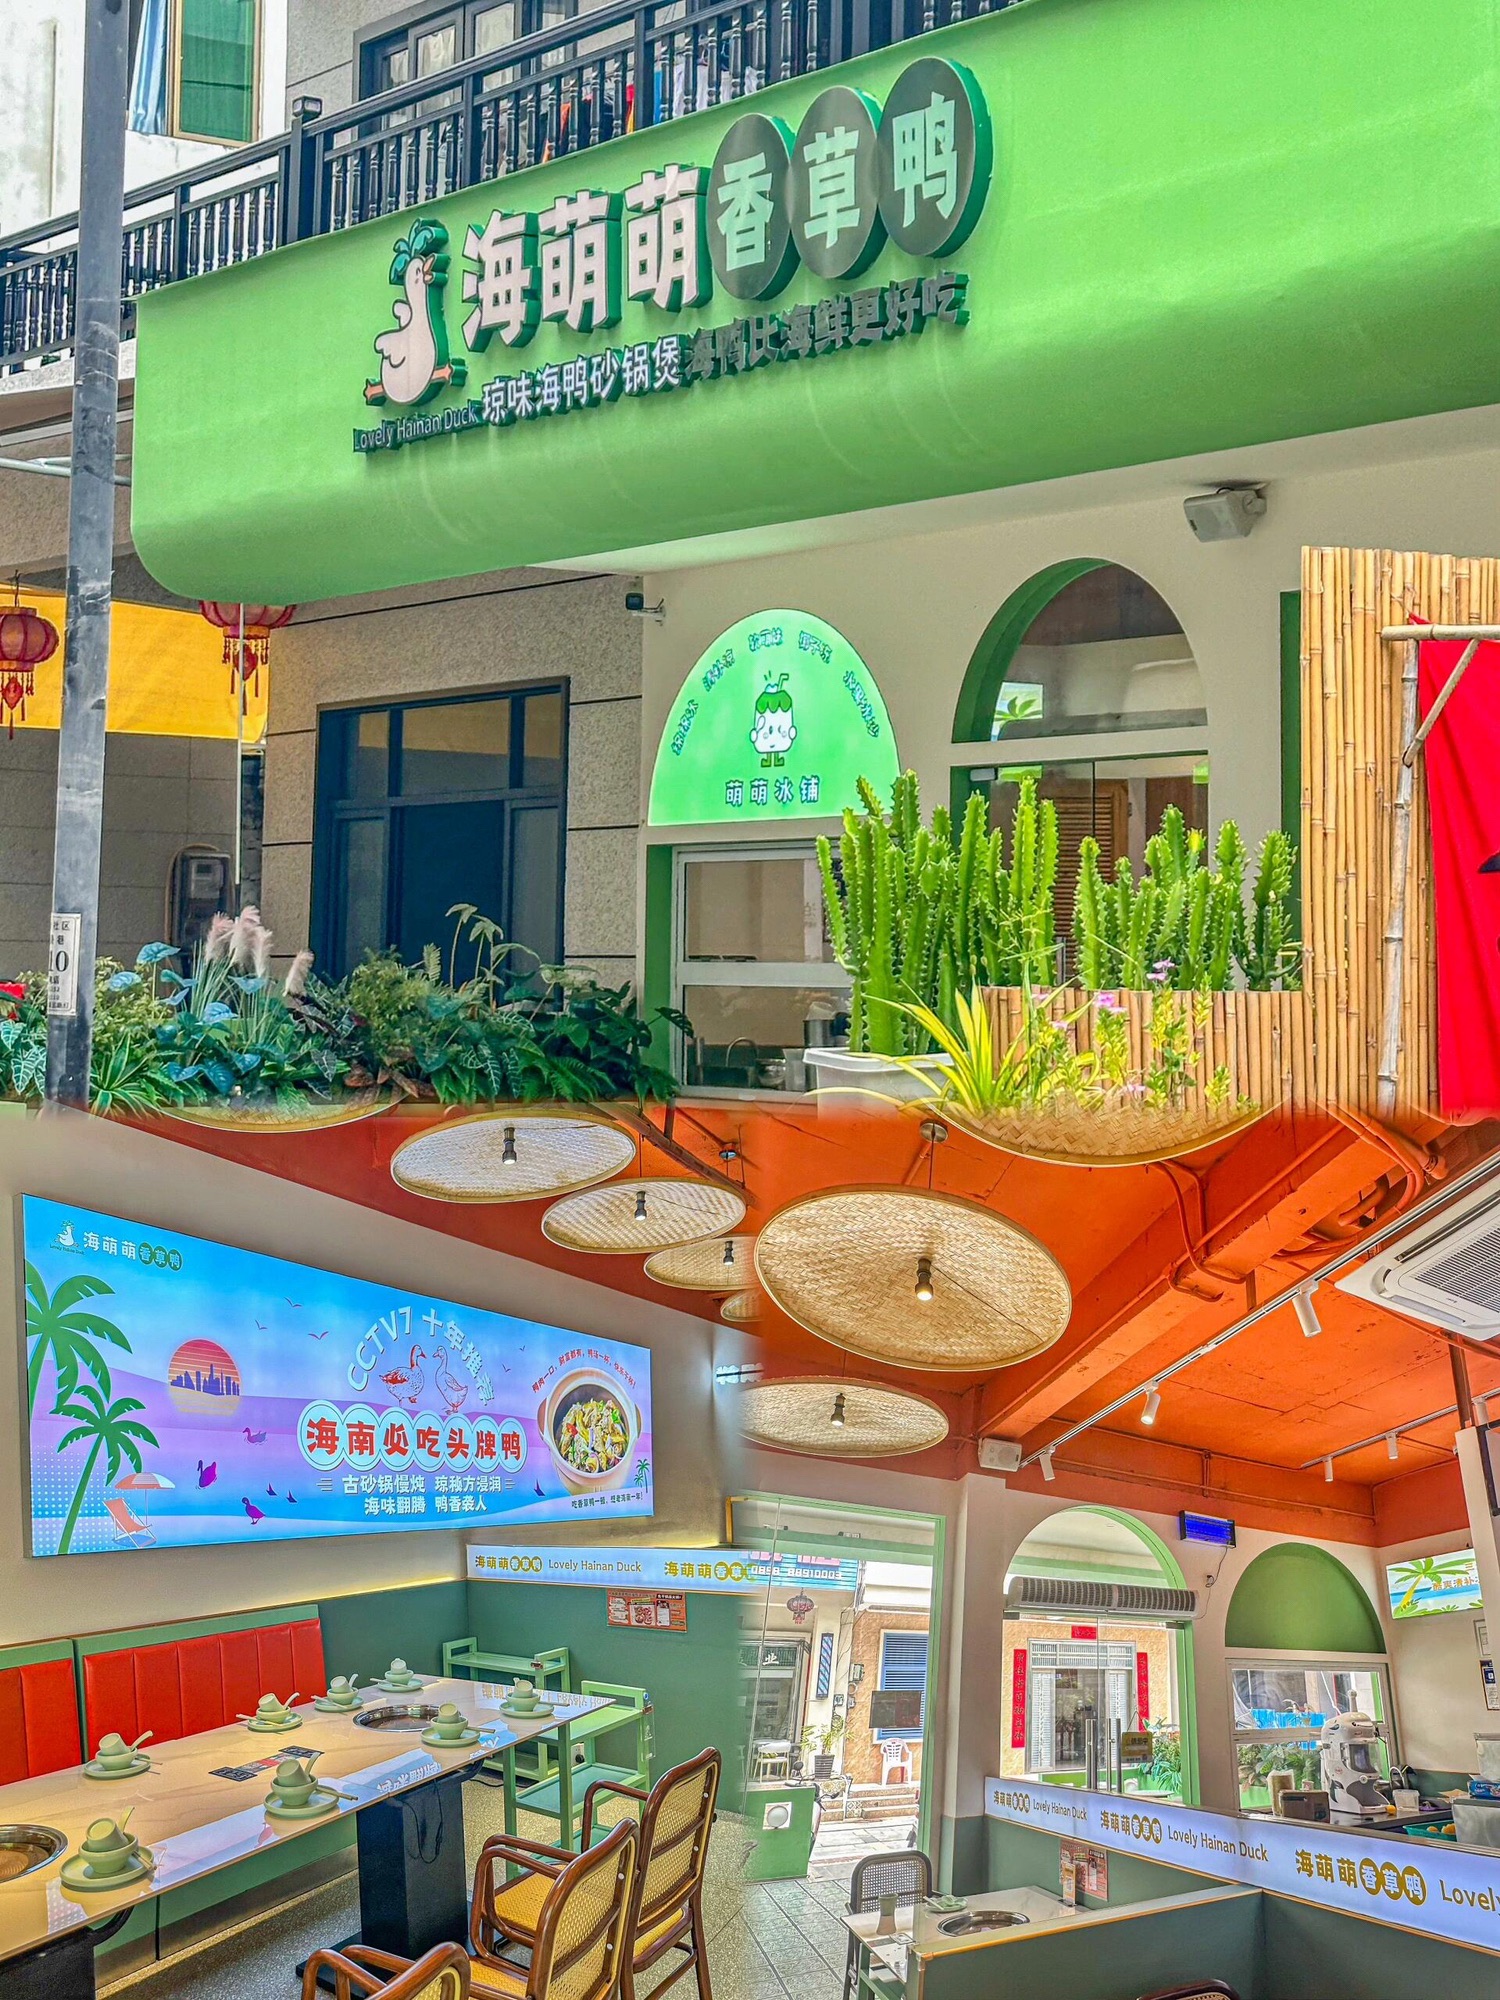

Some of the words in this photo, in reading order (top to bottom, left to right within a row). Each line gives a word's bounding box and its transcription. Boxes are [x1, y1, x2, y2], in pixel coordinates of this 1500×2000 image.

[462, 92, 958, 351] 海萌萌香草鸭
[482, 335, 680, 425] 琼味海鸭砂锅煲
[686, 270, 958, 381] 海鸭比海鲜更好吃
[354, 425, 394, 449] Lovely
[397, 413, 441, 440] Hainan
[443, 403, 480, 431] Duck
[725, 775, 821, 807] 萌萌冰铺
[83, 1231, 181, 1269] 海萌萌香草鸭
[347, 1306, 412, 1391] CCTV7
[306, 1417, 521, 1460] 海南必吃头牌鸭
[342, 1474, 427, 1494] 古砂锅慢炖
[364, 1496, 427, 1515] 海味翻腾
[435, 1495, 487, 1513] 鸭香袭人
[548, 1559, 578, 1572] Lovely
[581, 1560, 614, 1572] Hainan
[616, 1561, 642, 1572] Duck
[664, 1561, 755, 1581] 海萌萌香草
[1433, 1576, 1480, 1592] 酷爽清补
[1033, 1798, 1051, 1814] Lovely
[1051, 1804, 1071, 1817] Hainan
[1072, 1806, 1088, 1821] Duck
[1101, 1810, 1162, 1843] 海萌萌香草鸭
[1167, 1825, 1198, 1849] Lovely
[1200, 1832, 1236, 1855] Hainan
[1239, 1841, 1269, 1862] Duck
[1295, 1849, 1425, 1901] 海萌萌香草鸭
